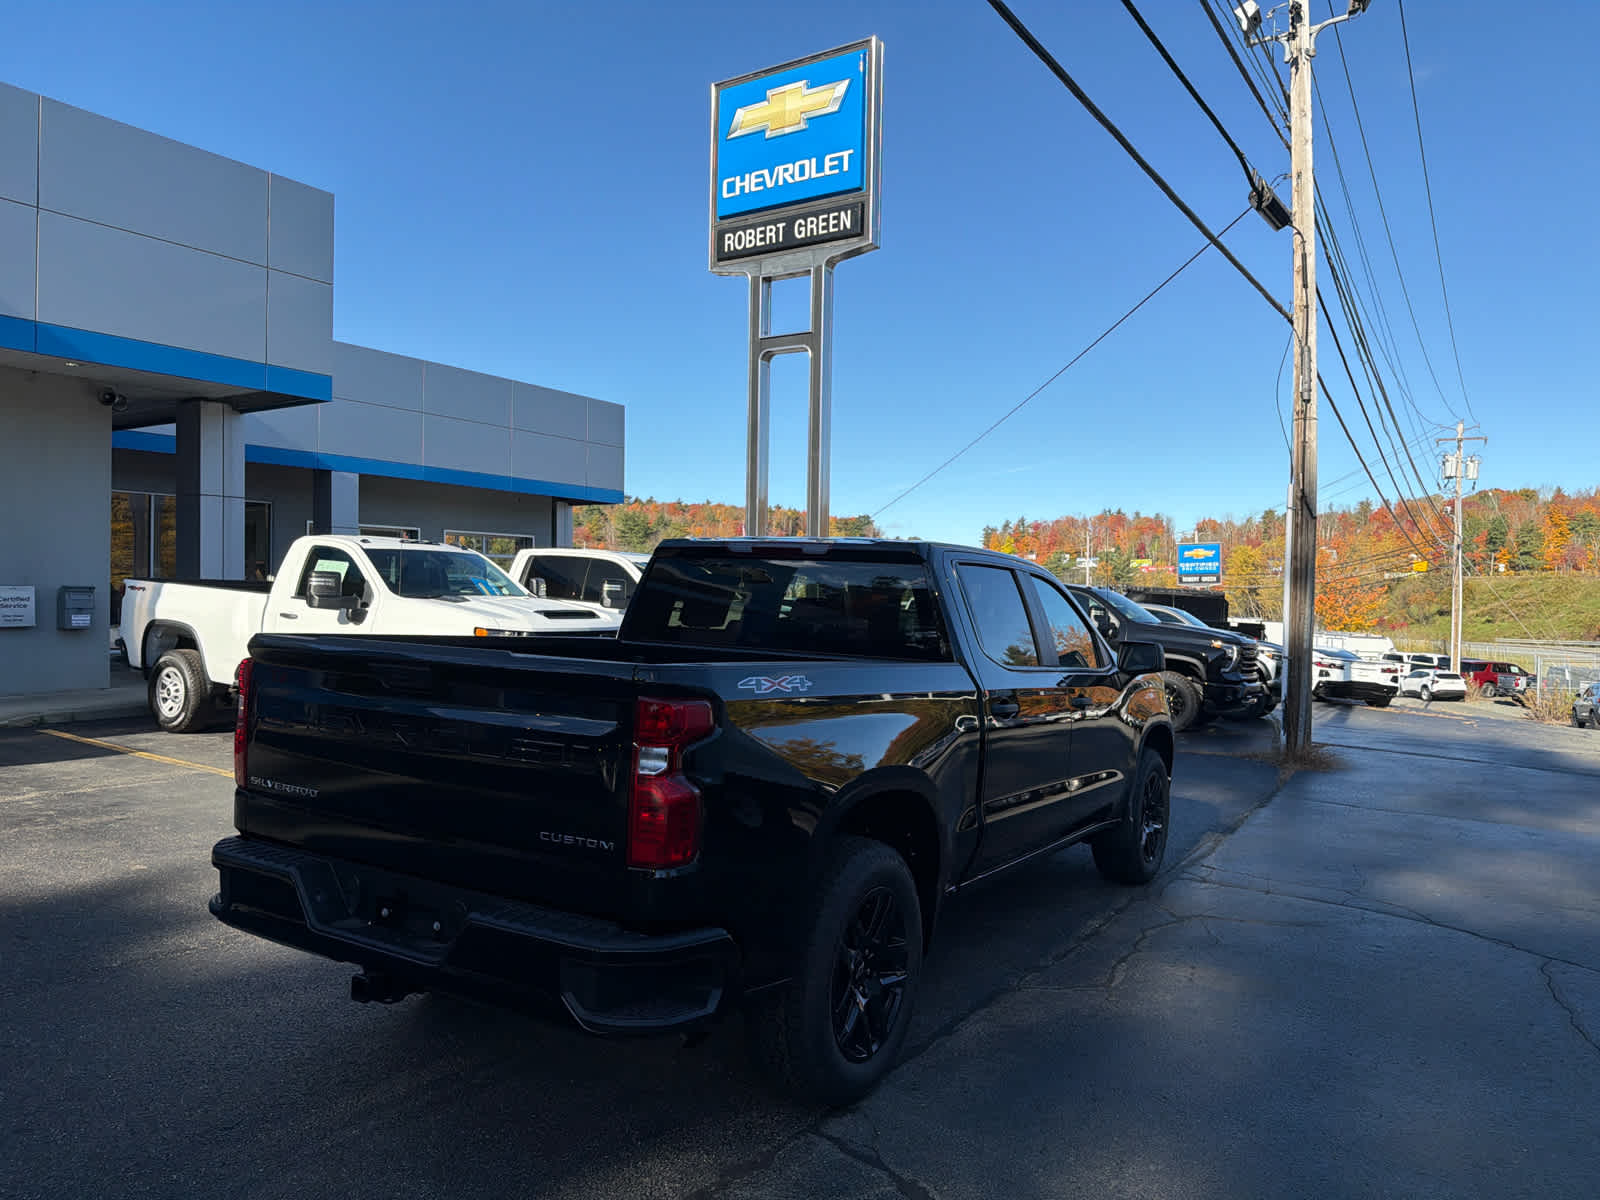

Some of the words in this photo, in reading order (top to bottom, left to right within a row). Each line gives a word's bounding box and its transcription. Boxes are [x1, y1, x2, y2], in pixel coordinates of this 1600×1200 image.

[721, 149, 854, 199] CHEVROLET
[724, 222, 787, 252] ROBERT
[794, 209, 852, 239] GREEN
[250, 776, 319, 798] SILVERADO
[539, 831, 615, 852] CUSTOM
